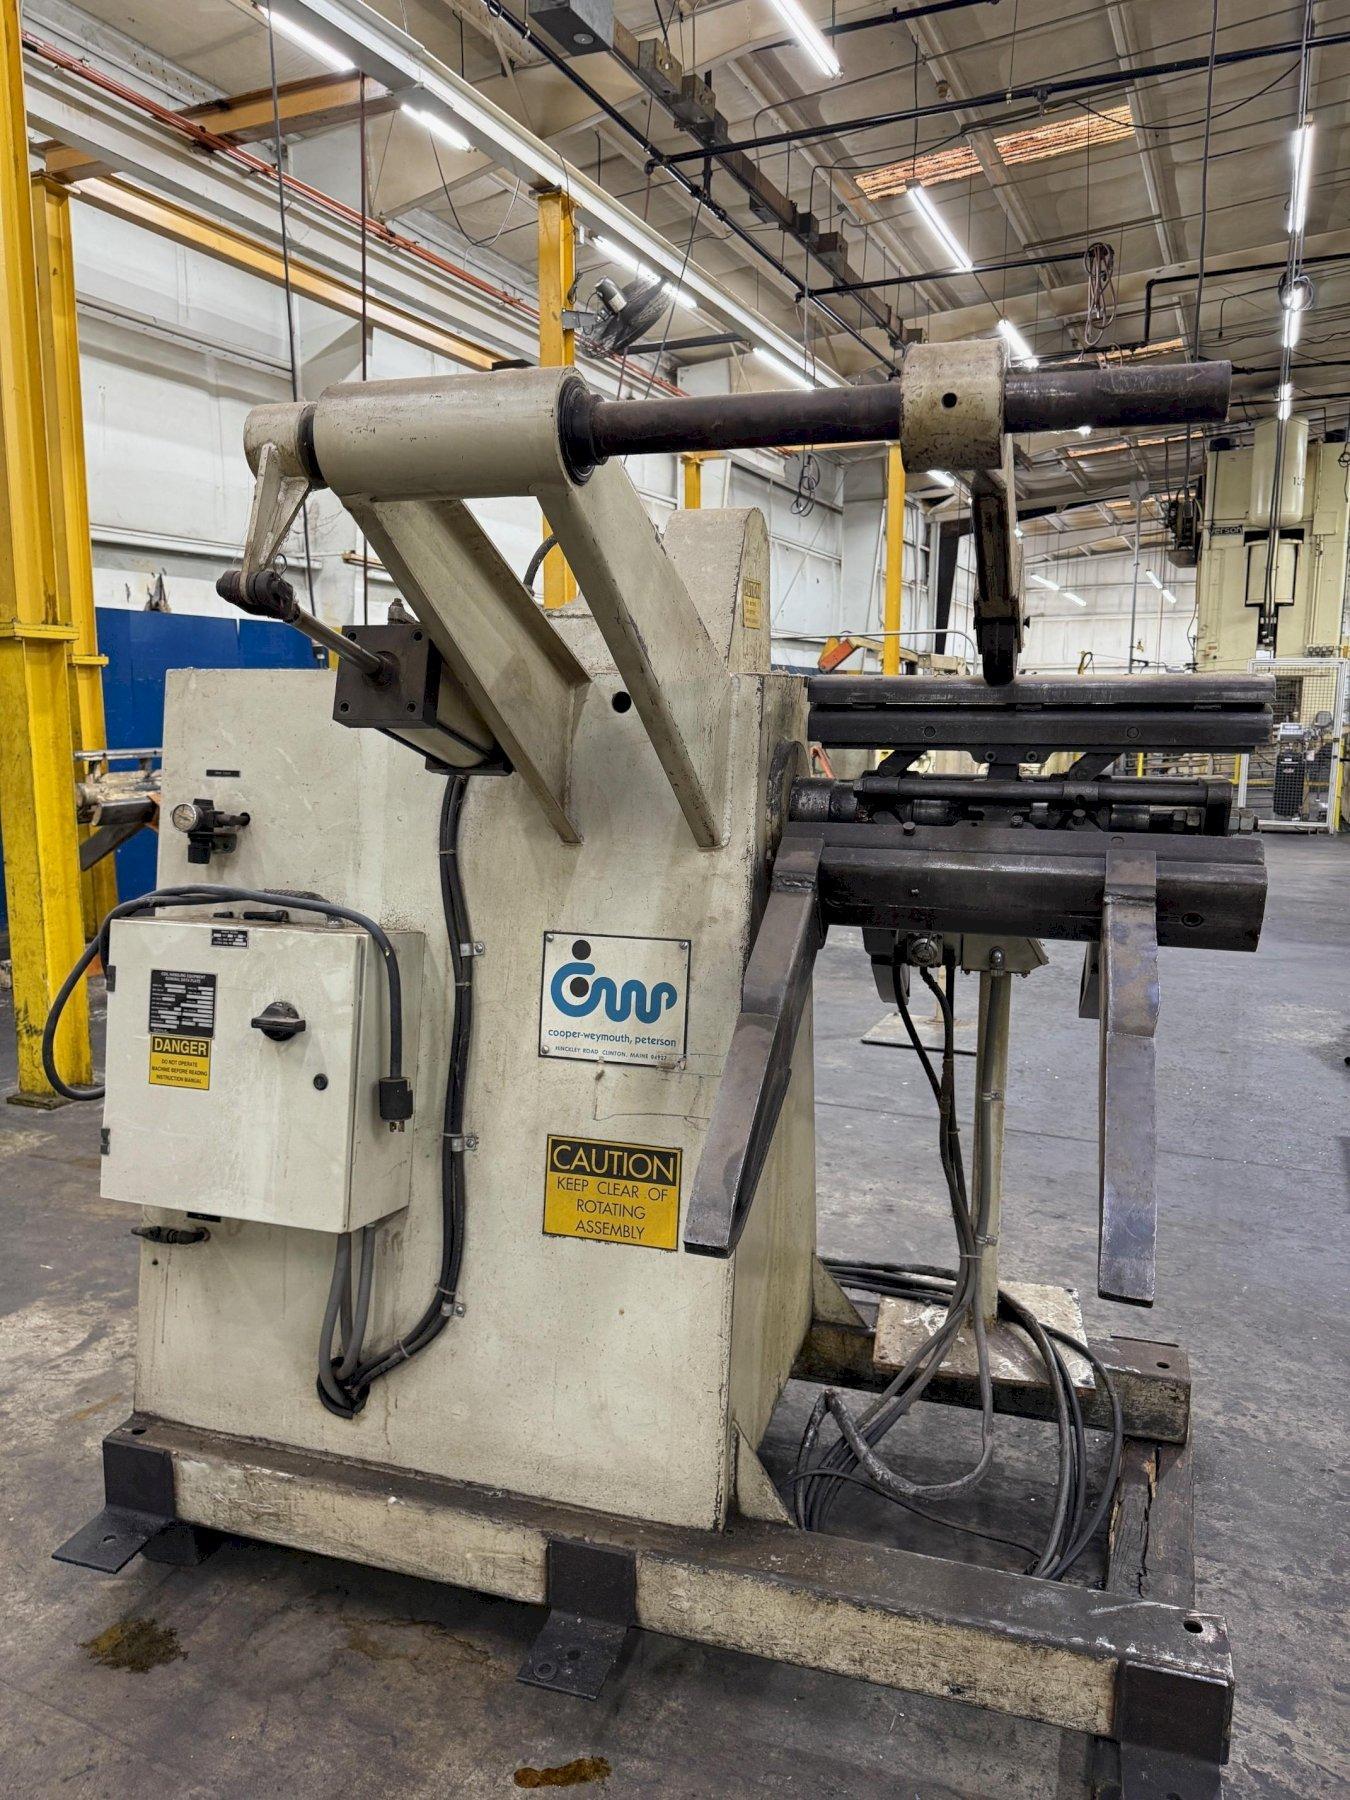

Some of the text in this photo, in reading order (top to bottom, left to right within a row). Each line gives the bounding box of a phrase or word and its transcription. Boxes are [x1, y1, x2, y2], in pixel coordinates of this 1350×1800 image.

[154, 1038, 207, 1056] DANGER
[548, 1029, 677, 1047] cooper-weymouth, peterson
[553, 1145, 674, 1183] CAUTION
[556, 1176, 668, 1202] KEEP CLEAR OF
[576, 1198, 646, 1220] ROTATING
[575, 1220, 645, 1240] ASSEMBLY
